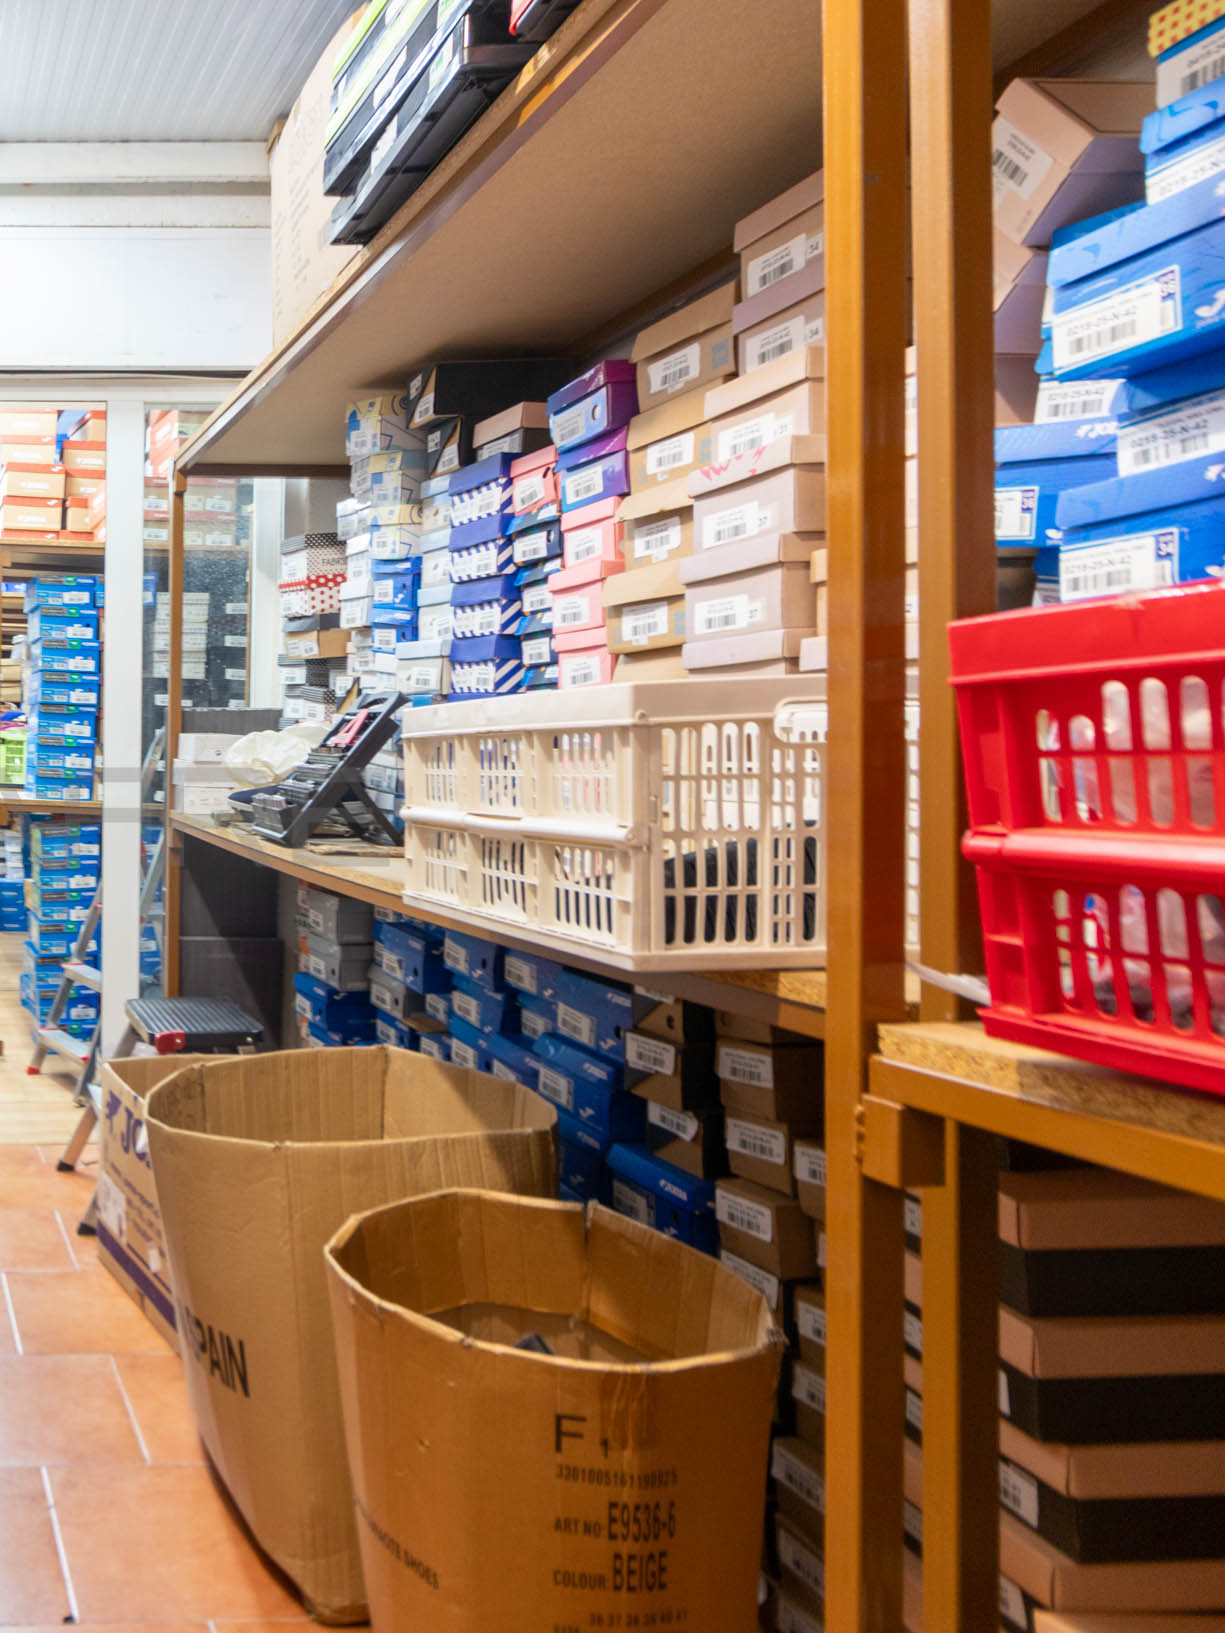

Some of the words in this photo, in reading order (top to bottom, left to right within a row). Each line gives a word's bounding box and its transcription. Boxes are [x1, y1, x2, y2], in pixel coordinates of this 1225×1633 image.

[555, 1413, 587, 1454] F
[554, 1517, 578, 1536] ART
[608, 1501, 675, 1541] E9536-6
[613, 1551, 668, 1593] BEIGE
